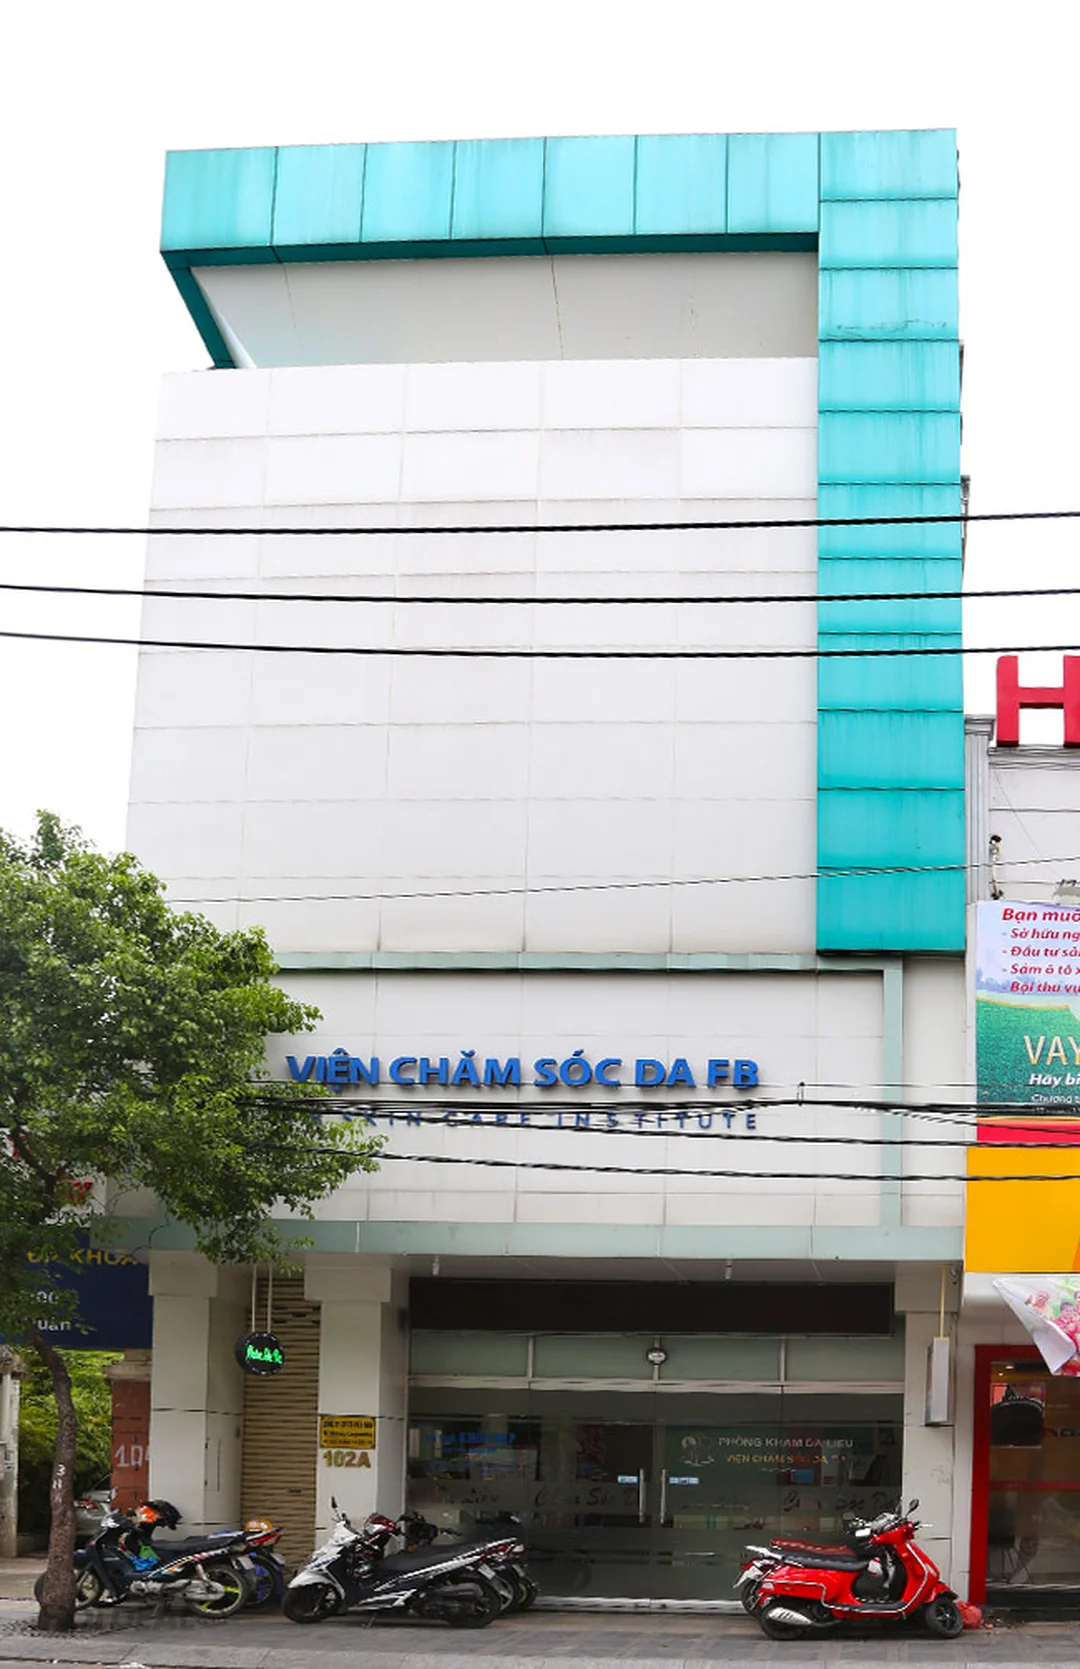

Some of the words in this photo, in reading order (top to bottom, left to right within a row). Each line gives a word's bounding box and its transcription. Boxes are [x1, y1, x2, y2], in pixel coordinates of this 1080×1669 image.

[1002, 907, 1038, 924] Bạn
[1010, 927, 1029, 939] Sở
[1044, 947, 1061, 957] tư
[1037, 981, 1061, 993] thu
[286, 1047, 379, 1092] VIỆN
[389, 1050, 522, 1088] CHĂM
[534, 1049, 621, 1088] SÓC
[634, 1058, 696, 1088] DA
[707, 1058, 759, 1089] FB
[323, 1449, 371, 1469] 102A
